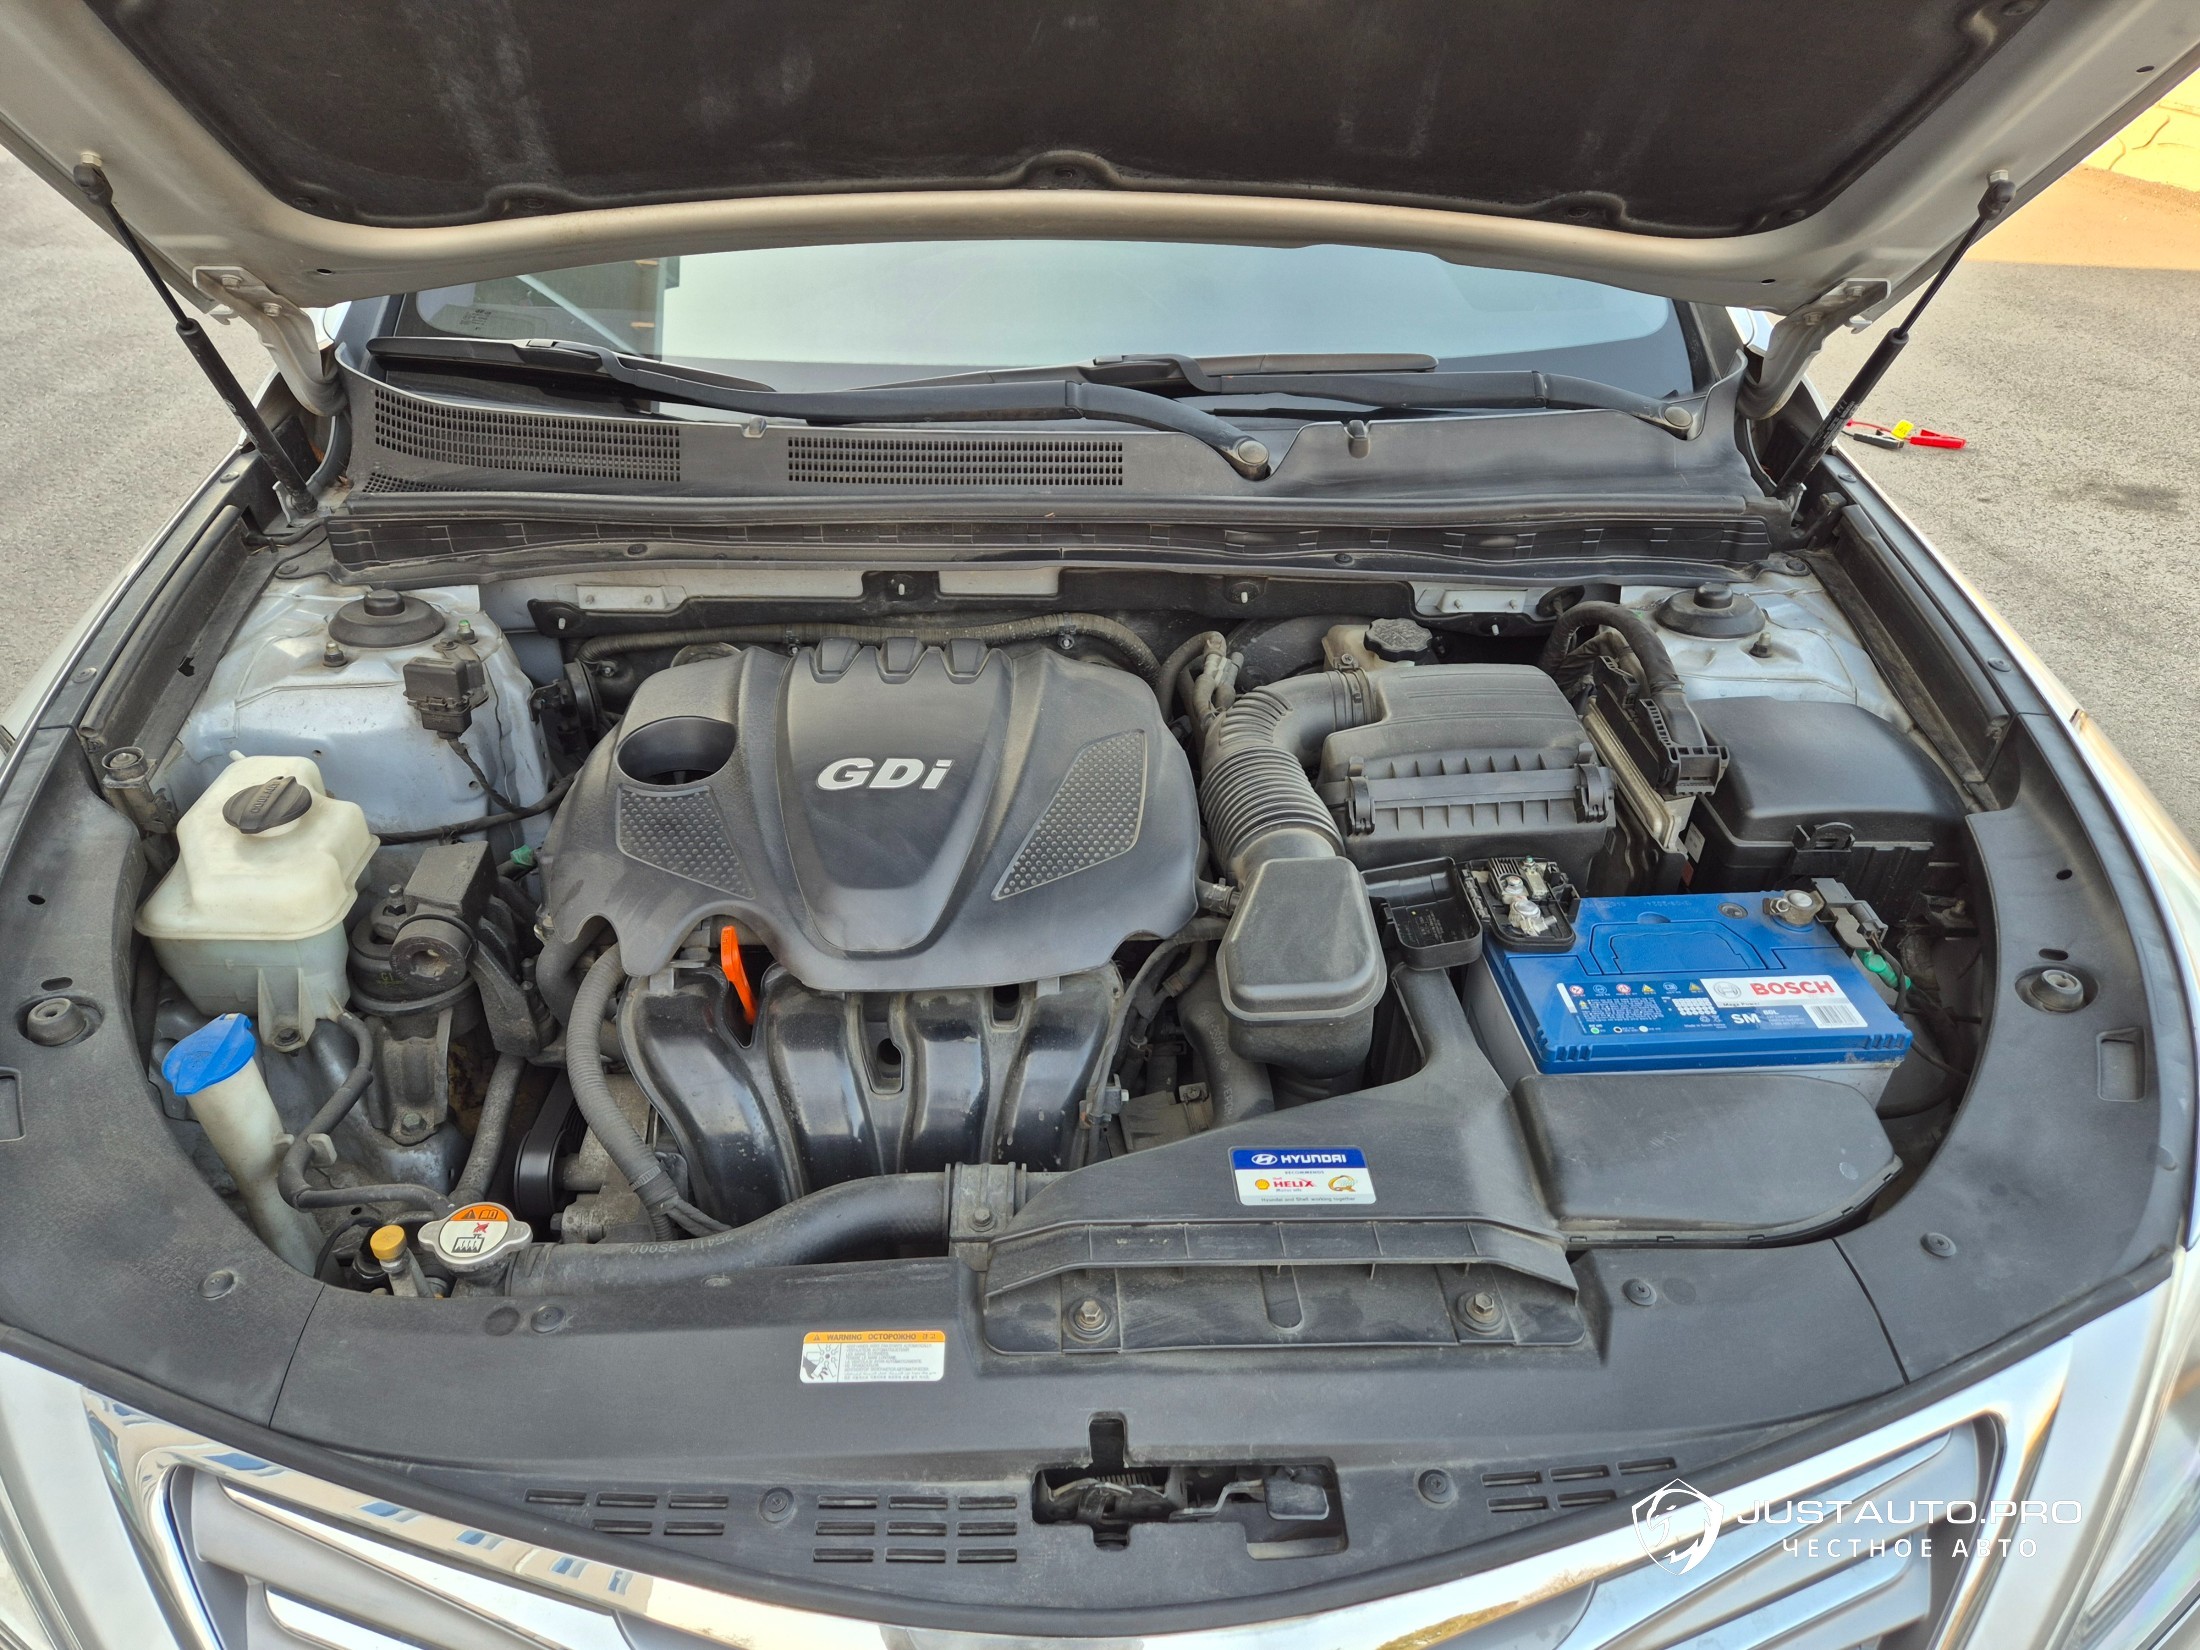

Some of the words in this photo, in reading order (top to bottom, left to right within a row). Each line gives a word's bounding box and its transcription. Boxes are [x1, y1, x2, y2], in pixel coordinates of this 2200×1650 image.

[816, 757, 955, 790] GDi
[1750, 980, 1836, 995] BOSCH
[1731, 1013, 1762, 1024] SM
[1280, 1153, 1347, 1164] HYUNDAI
[1273, 1180, 1315, 1188] HELIX
[868, 1333, 917, 1341] ОСТОРОЖНО
